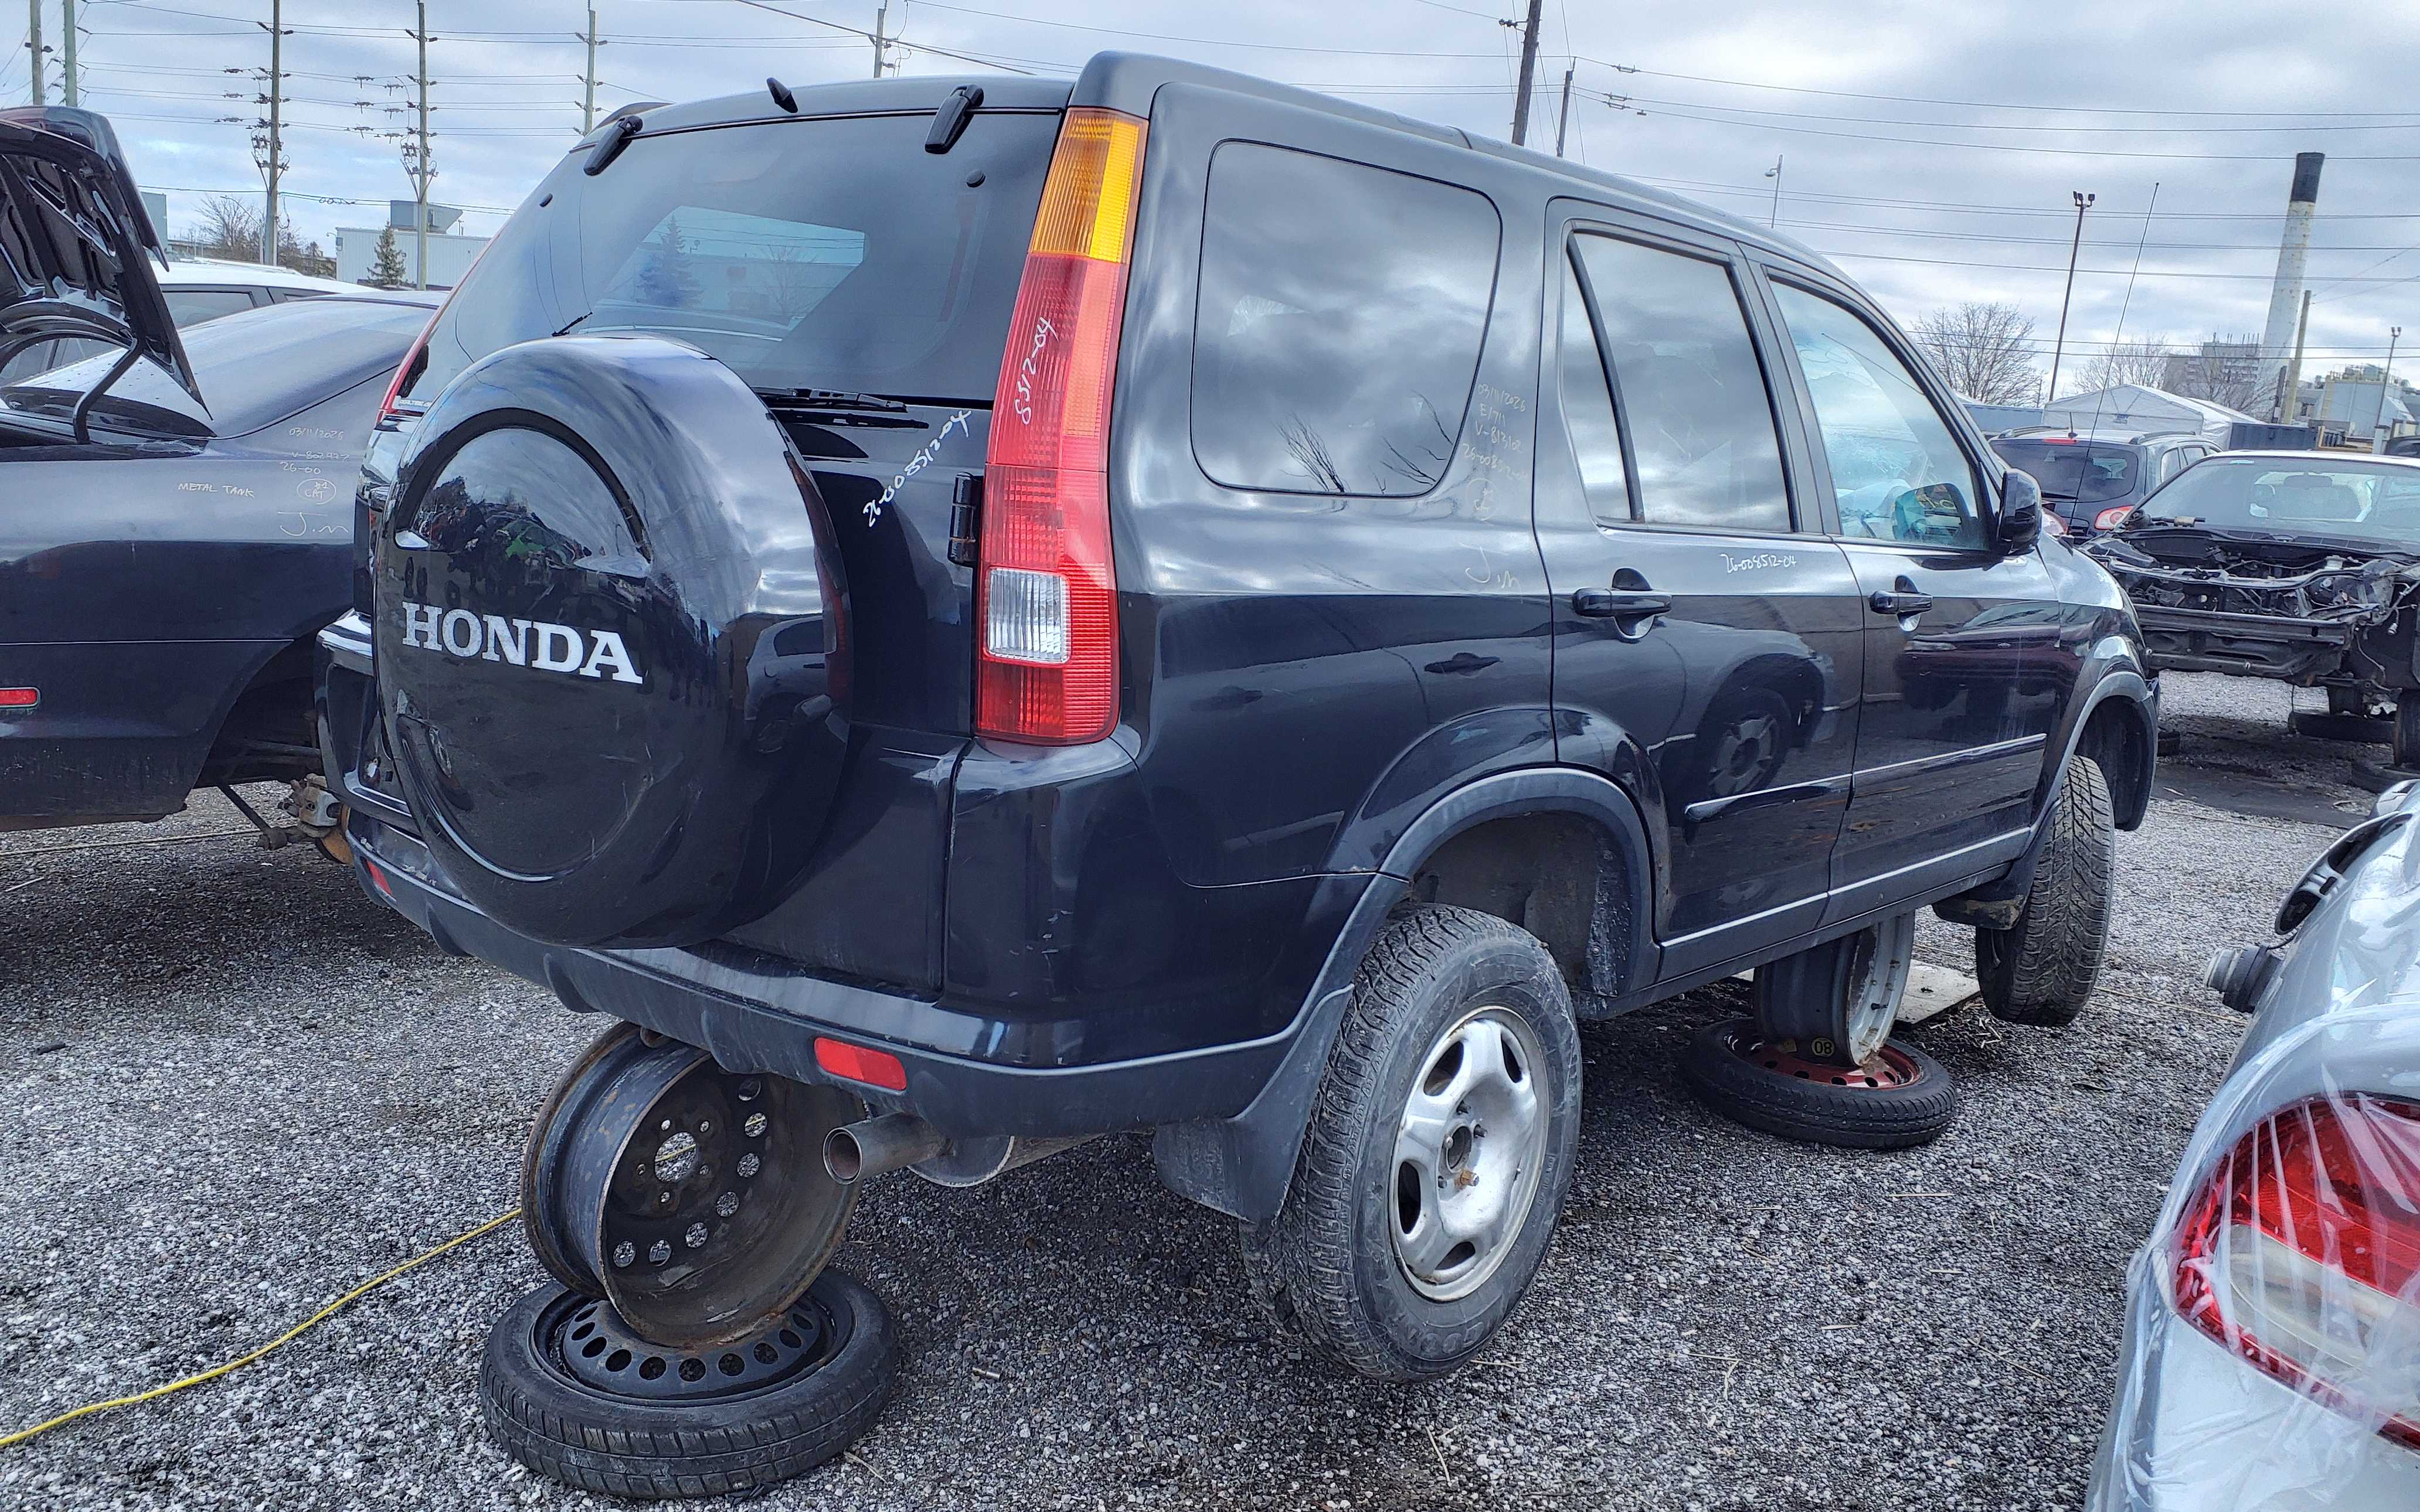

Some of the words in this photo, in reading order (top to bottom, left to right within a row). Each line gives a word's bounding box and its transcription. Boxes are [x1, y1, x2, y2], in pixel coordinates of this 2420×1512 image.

[1015, 316, 1059, 424] 8512-04
[289, 427, 344, 441] 03/11/2026
[280, 461, 321, 474] 26-00
[178, 482, 217, 493] METAL
[222, 485, 254, 498] TANK
[402, 601, 644, 685] HONDA
